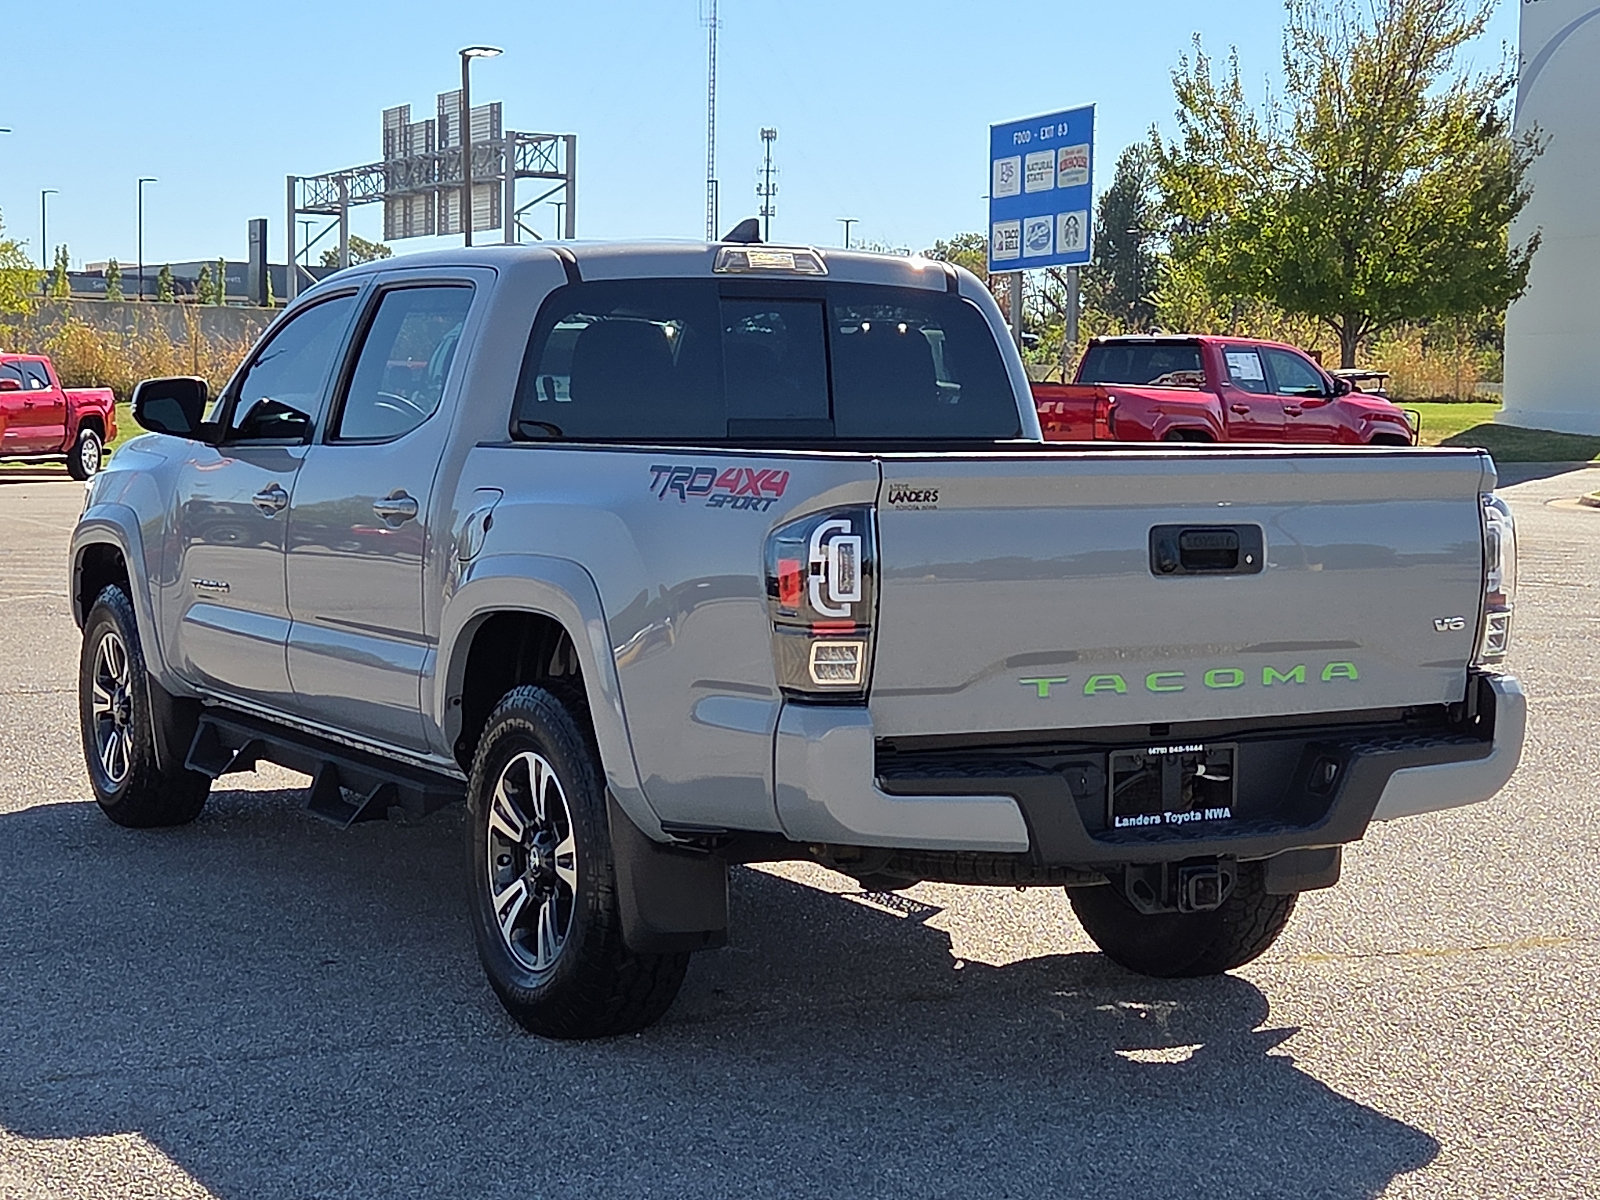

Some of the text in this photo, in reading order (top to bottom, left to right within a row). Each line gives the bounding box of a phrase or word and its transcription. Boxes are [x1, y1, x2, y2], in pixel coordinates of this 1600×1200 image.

[1013, 130, 1031, 145] FOOD
[1040, 126, 1055, 140] EXIT
[1027, 159, 1053, 172] NATURAL
[1027, 172, 1044, 183] STATE
[1004, 228, 1018, 240] TACO
[1004, 239, 1018, 251] BELL
[650, 465, 717, 503] TRD
[705, 493, 778, 512] SPORT
[888, 490, 938, 504] LANDERS
[1433, 616, 1465, 632] V6
[1018, 662, 1359, 698] TACOMA
[1115, 807, 1231, 827] Landers Toyota NWA
